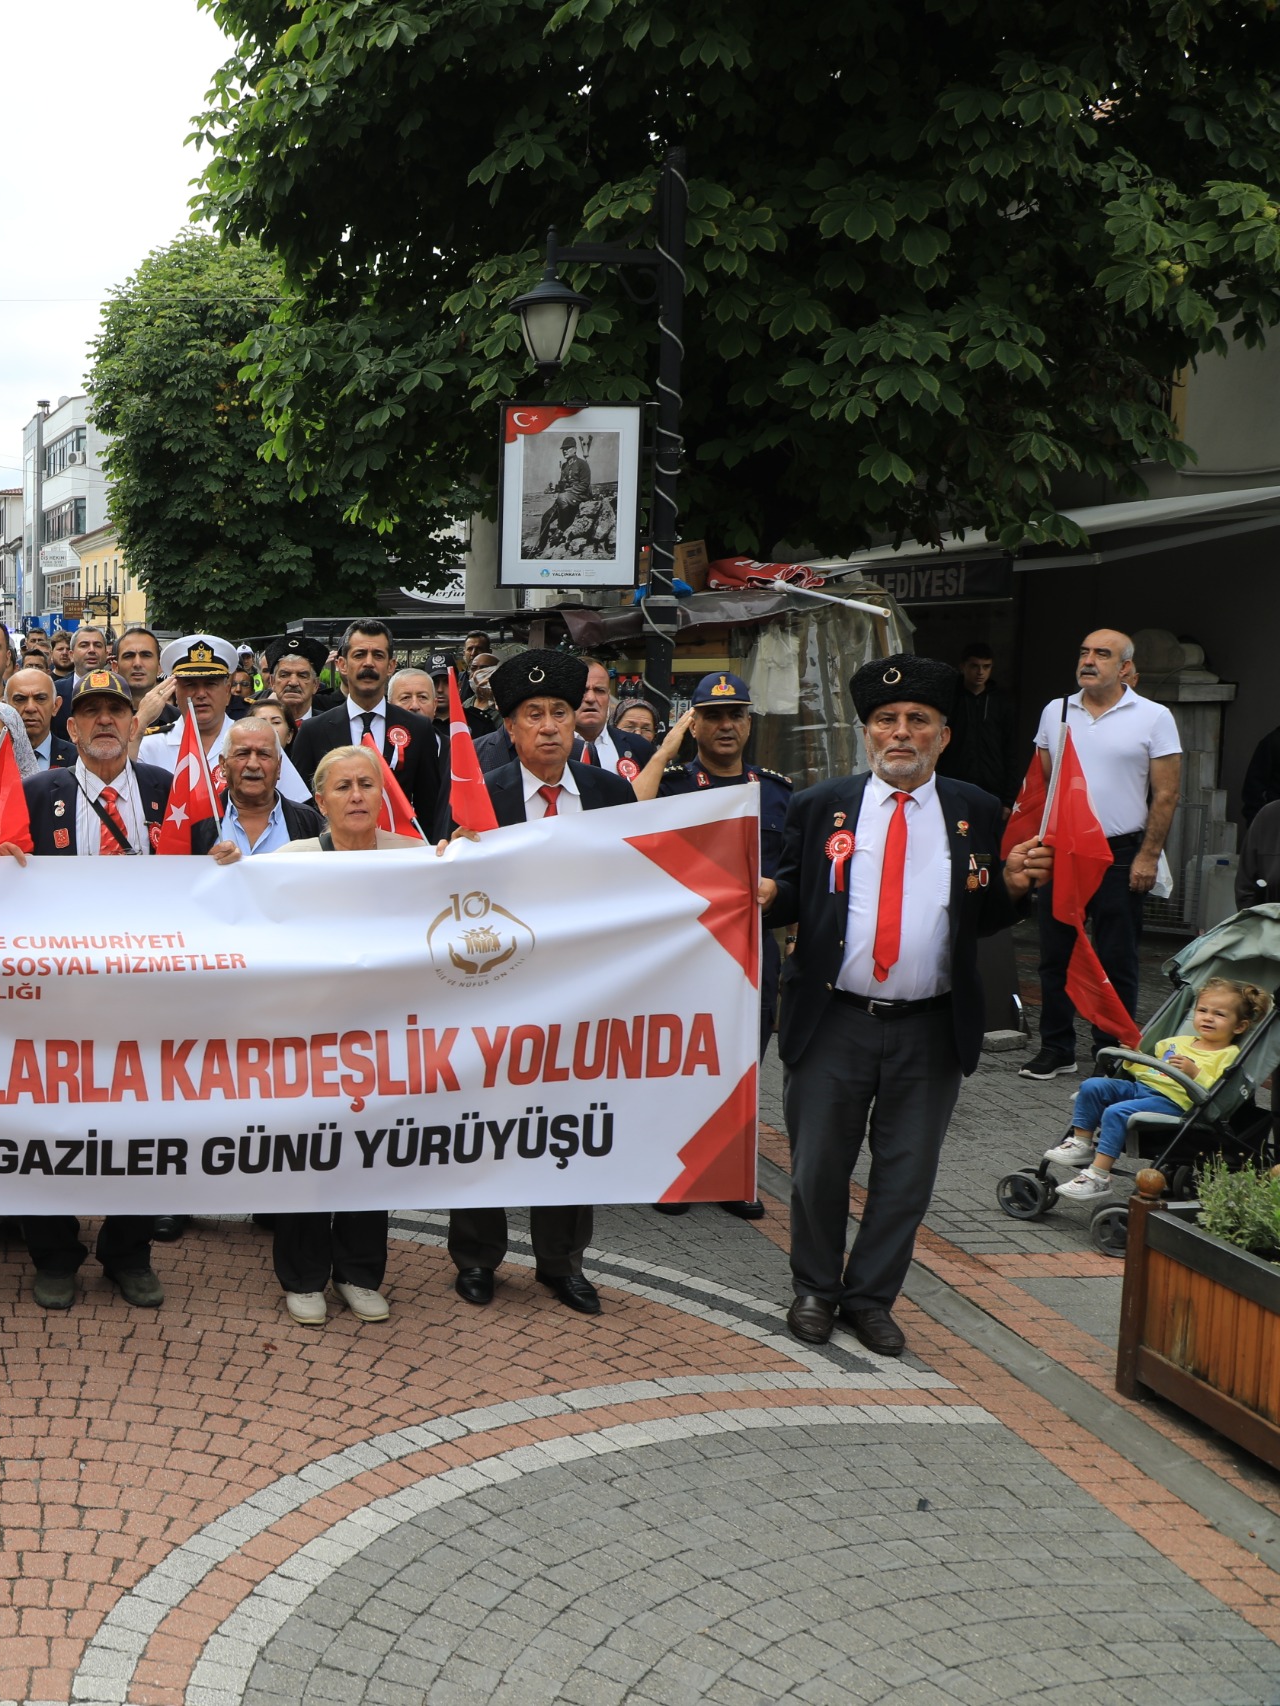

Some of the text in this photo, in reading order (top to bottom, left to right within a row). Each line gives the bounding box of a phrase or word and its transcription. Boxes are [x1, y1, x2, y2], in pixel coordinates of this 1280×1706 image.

[12, 928, 184, 950] CUMHURİYETİ
[2, 955, 99, 976] SOSYAL
[105, 949, 247, 975] HİZMETLER
[493, 971, 508, 981] ON
[161, 1014, 461, 1113] KARDEŞLİK
[470, 1012, 721, 1089] YOLUNDA
[200, 1122, 342, 1175] GÜNÜ
[354, 1102, 615, 1170] YÜRÜYÜŞÜ
